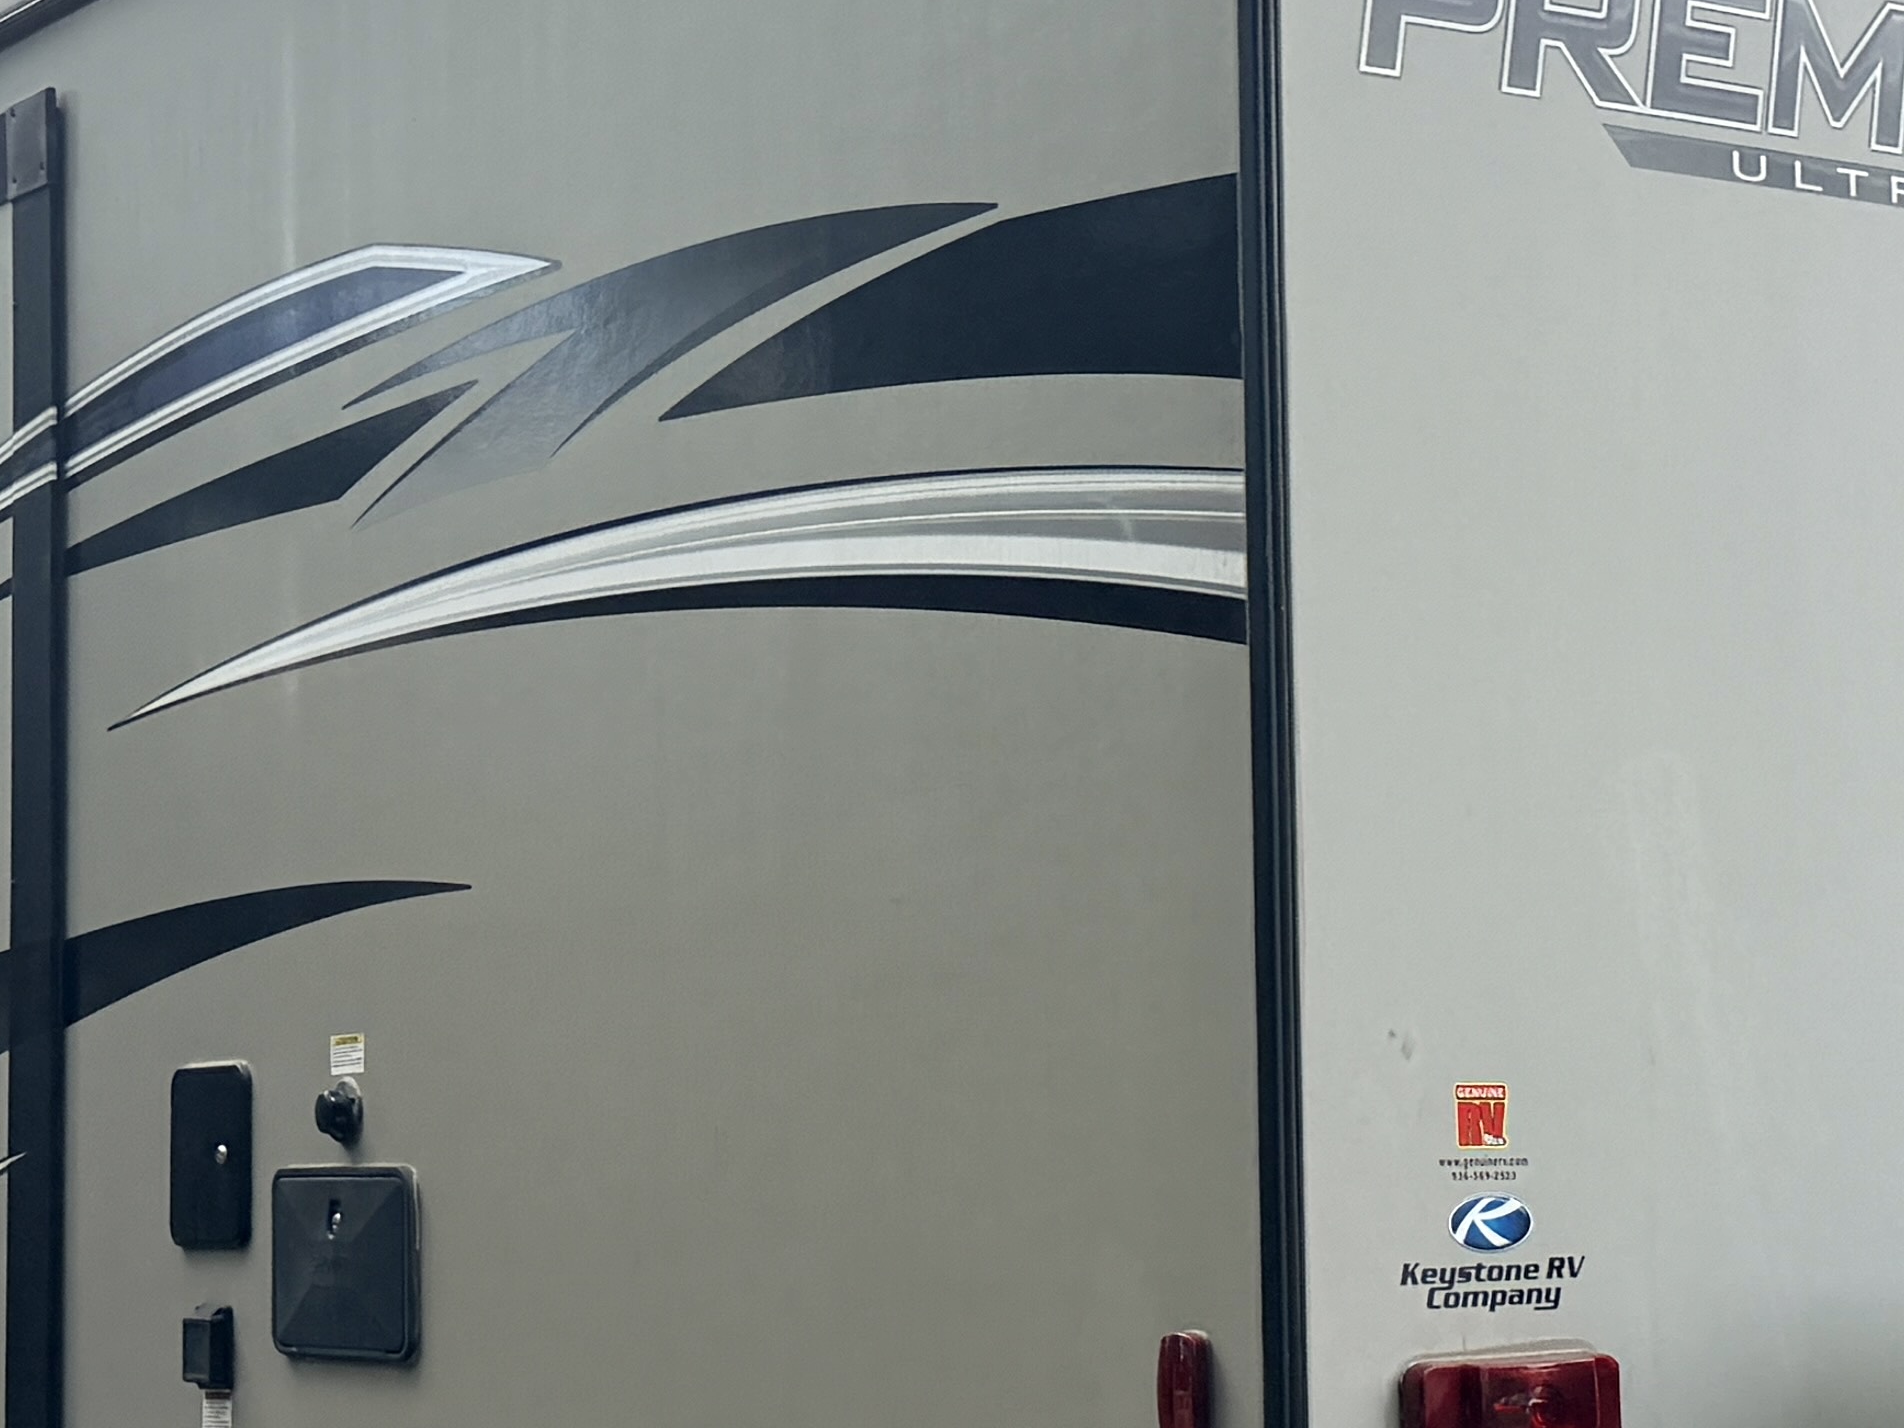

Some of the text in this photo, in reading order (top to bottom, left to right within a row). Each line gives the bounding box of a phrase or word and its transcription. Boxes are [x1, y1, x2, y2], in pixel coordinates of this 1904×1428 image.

[1400, 1255, 1585, 1290] Keystone RV
[1427, 1286, 1562, 1312] Company
